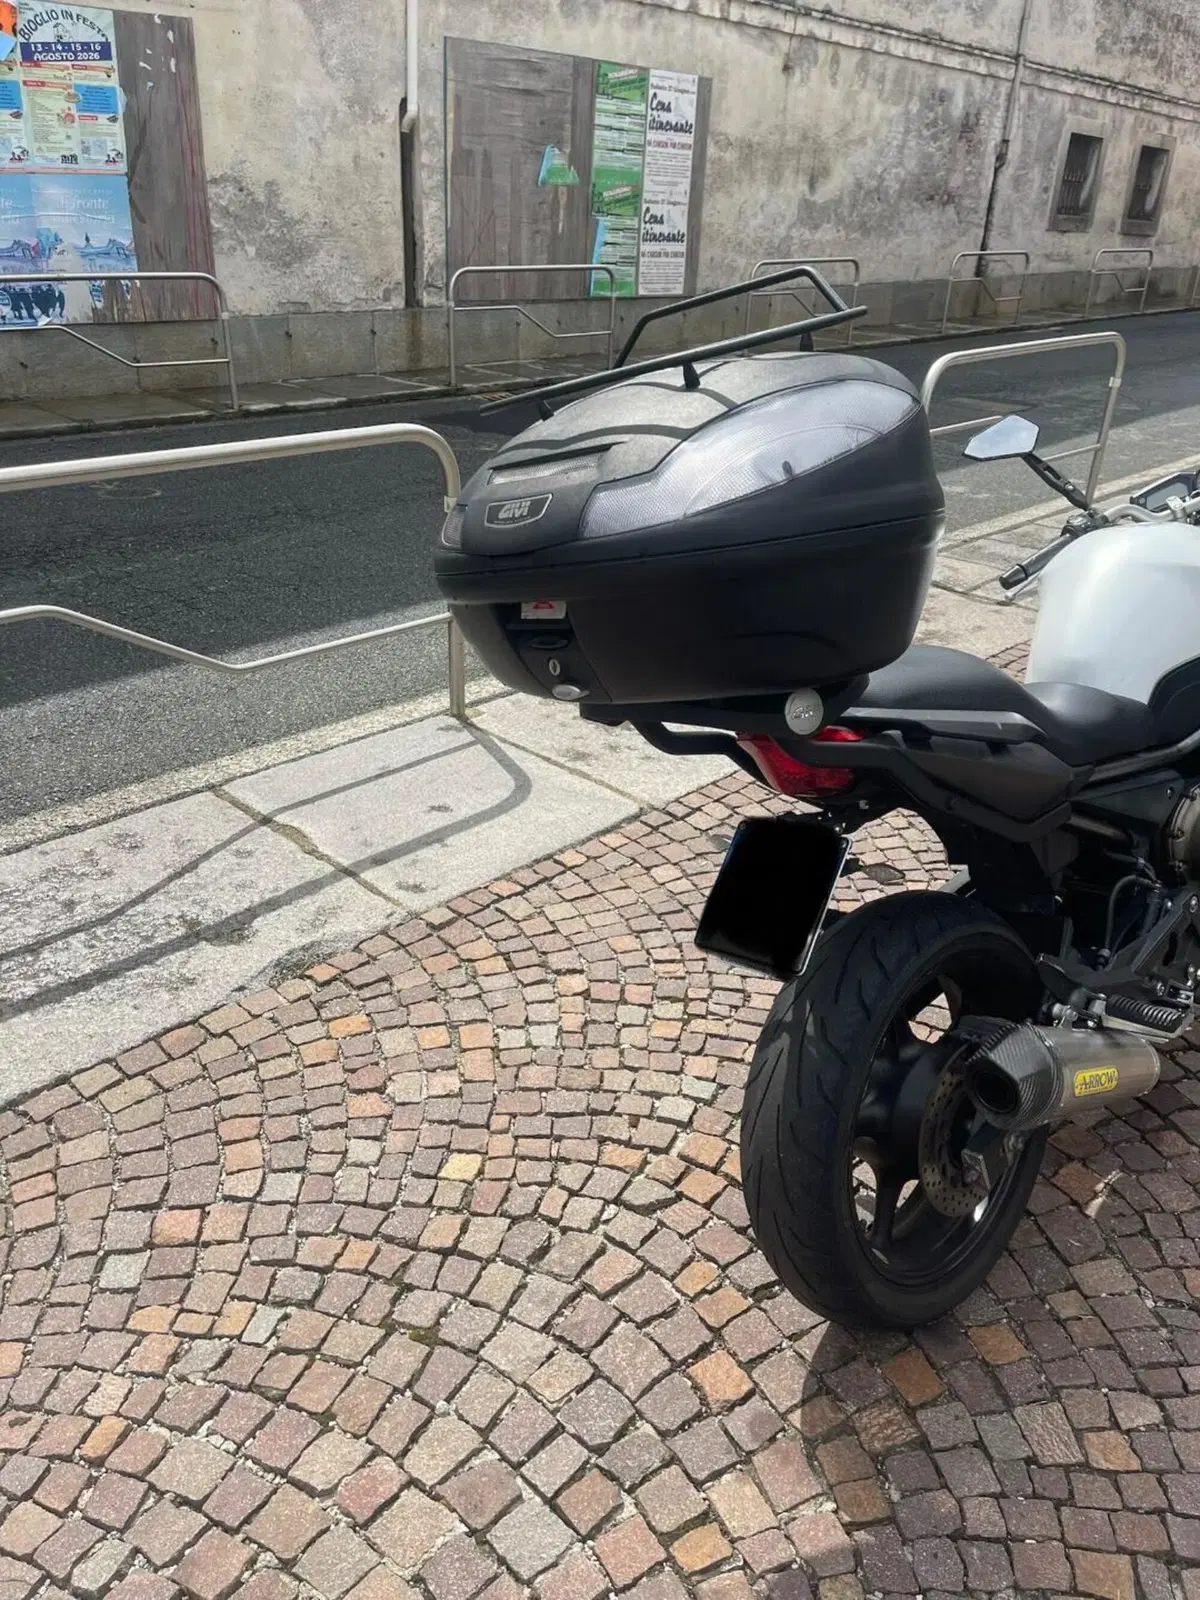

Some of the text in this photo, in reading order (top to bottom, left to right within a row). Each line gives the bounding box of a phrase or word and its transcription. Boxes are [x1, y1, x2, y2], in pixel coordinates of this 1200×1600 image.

[19, 9, 59, 43] BIOGLIO
[60, 9, 74, 21] IN
[30, 43, 43, 51] 13
[51, 43, 63, 51] 14
[70, 43, 82, 51] 15
[90, 43, 101, 51] 16
[33, 52, 100, 61] AGOSTO 2026
[650, 91, 672, 113] Cena
[648, 114, 693, 134] itinerante
[643, 206, 664, 225] Cena
[642, 227, 685, 243] itinerante
[498, 501, 531, 519] GIVI
[1080, 1070, 1116, 1091] ARROW
